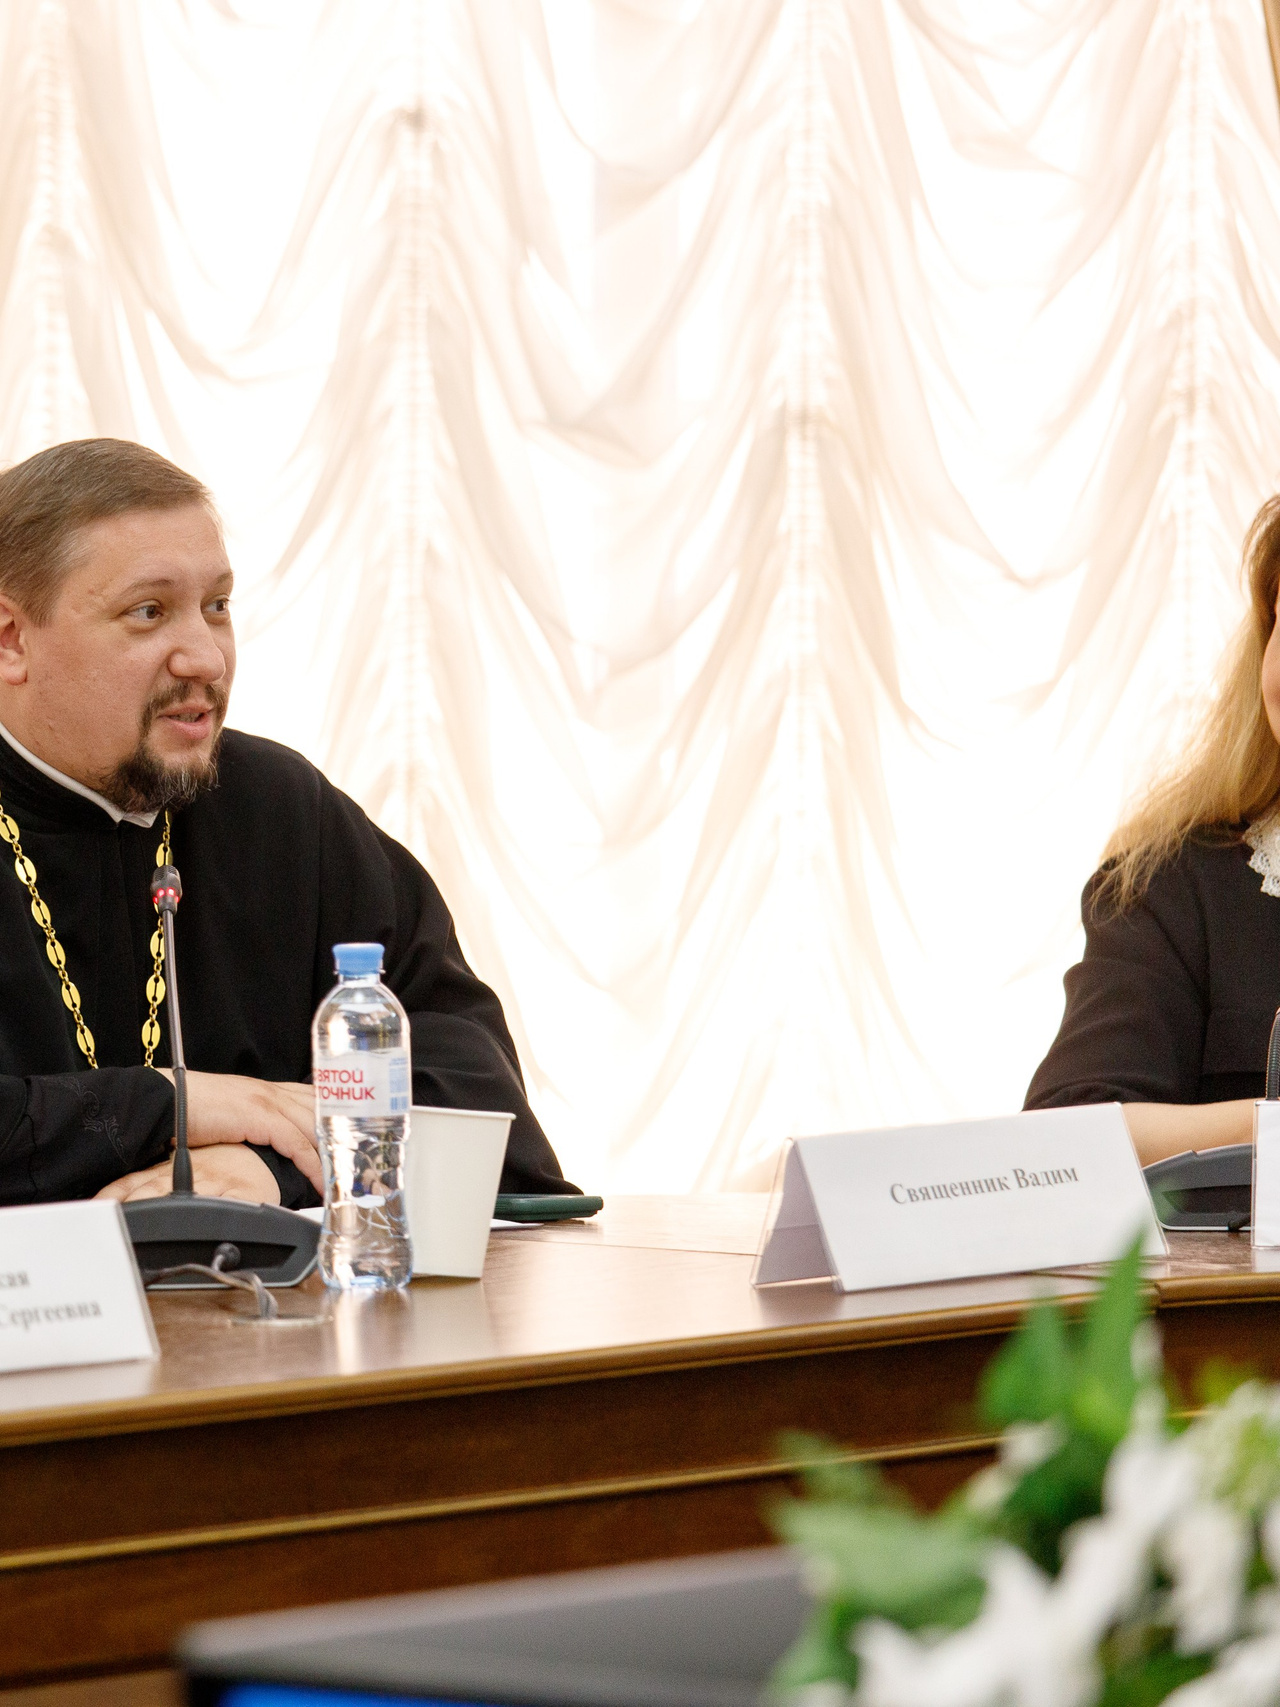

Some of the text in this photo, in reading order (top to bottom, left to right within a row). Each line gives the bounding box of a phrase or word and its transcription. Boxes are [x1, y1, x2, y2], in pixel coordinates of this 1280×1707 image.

[317, 1068, 363, 1084] ВЯТОЙ
[317, 1086, 376, 1101] ТОЧНИК
[889, 1167, 1079, 1205] Священник Вадим
